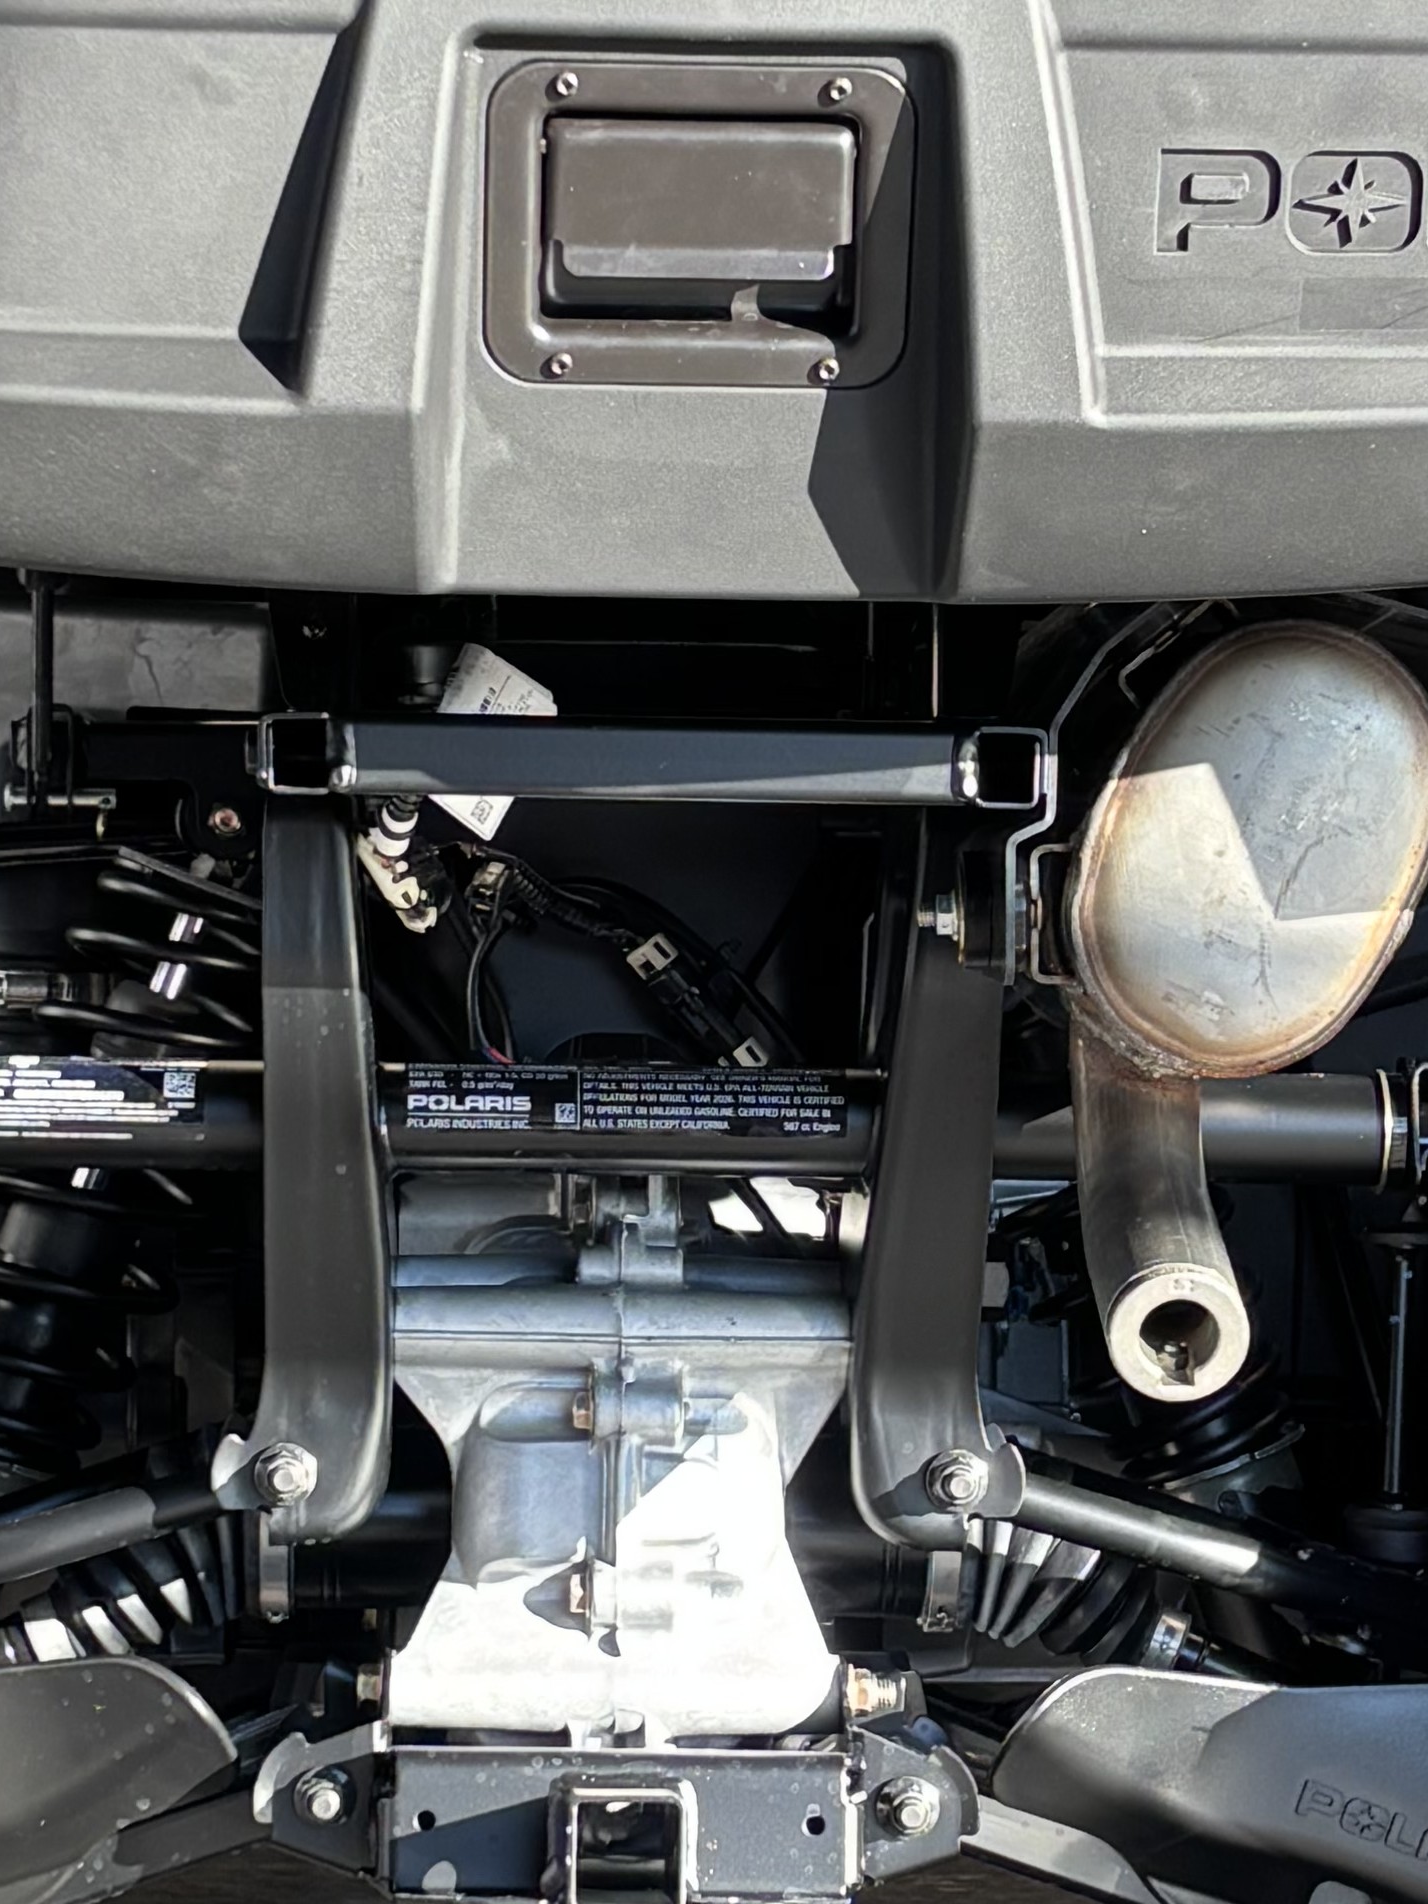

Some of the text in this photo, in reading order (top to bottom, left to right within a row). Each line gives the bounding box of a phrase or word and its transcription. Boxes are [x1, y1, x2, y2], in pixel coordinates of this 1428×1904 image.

[407, 1094, 532, 1111] POLARIS
[406, 1118, 451, 1129] POLARIS
[617, 1119, 648, 1129] STATES
[649, 1119, 680, 1129] EXCEPT
